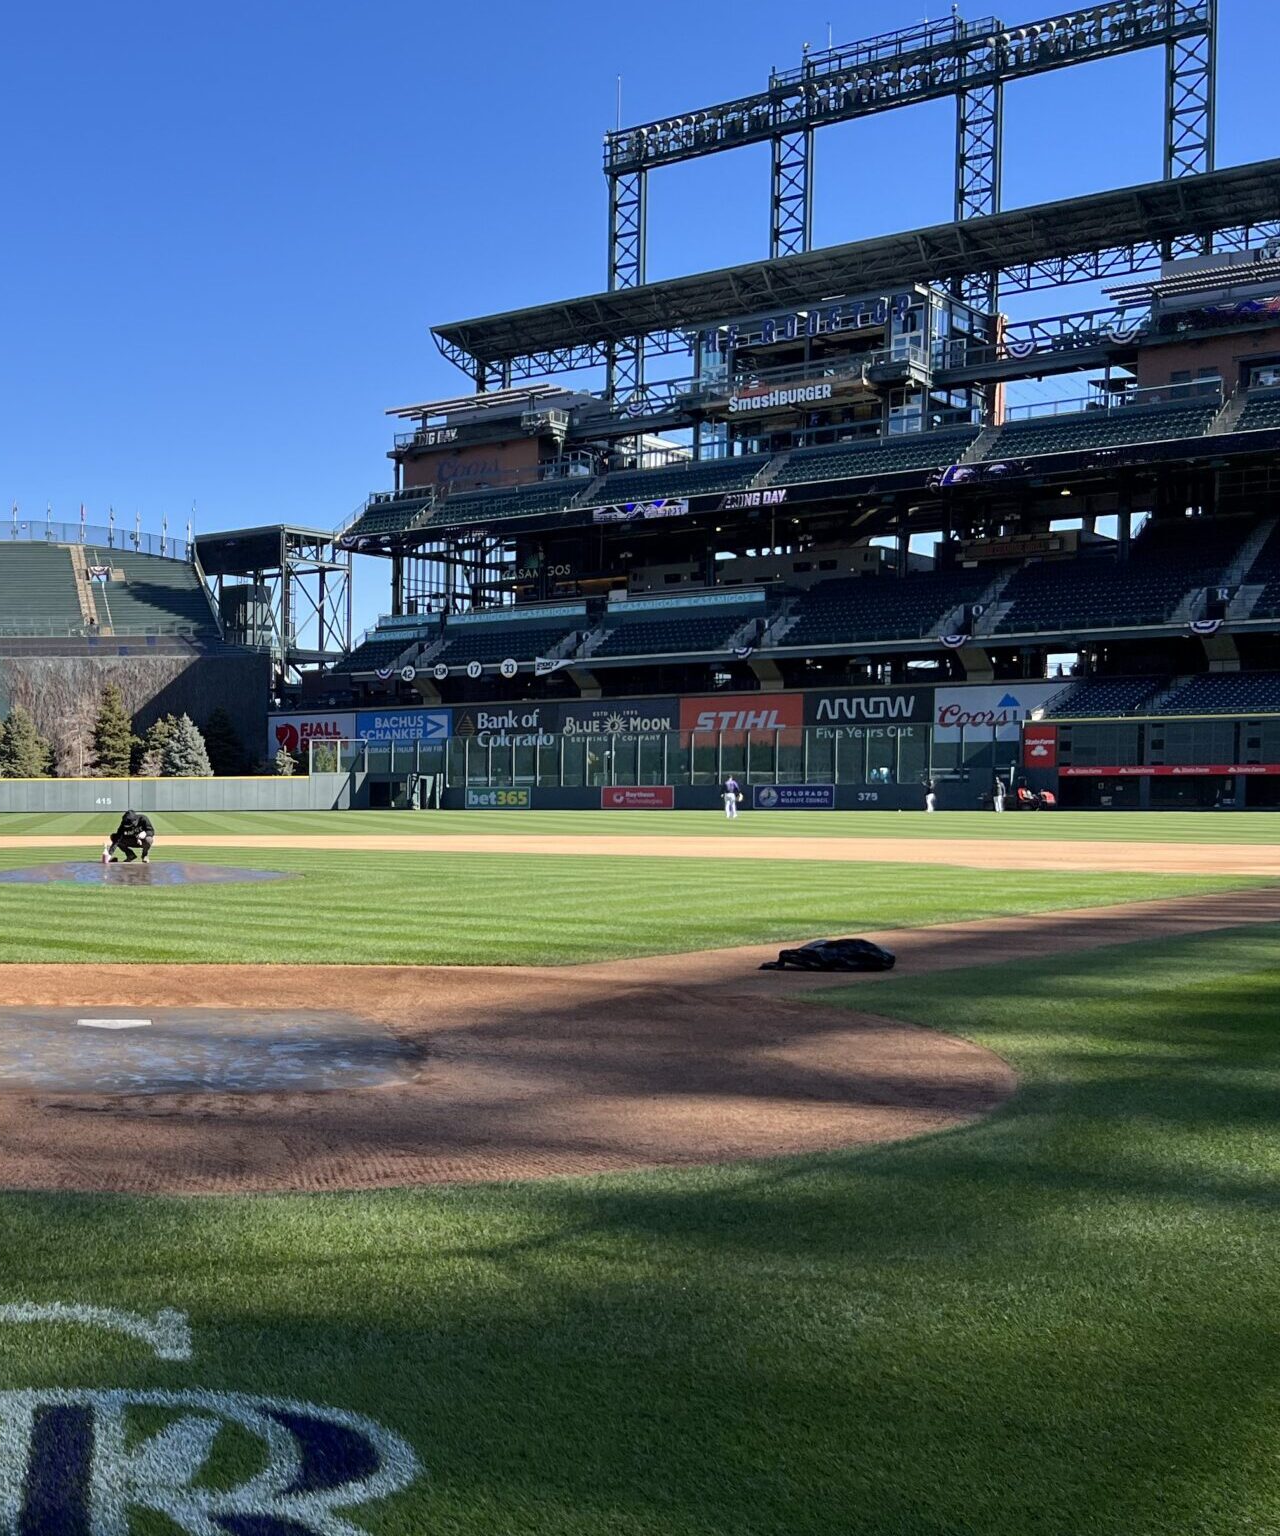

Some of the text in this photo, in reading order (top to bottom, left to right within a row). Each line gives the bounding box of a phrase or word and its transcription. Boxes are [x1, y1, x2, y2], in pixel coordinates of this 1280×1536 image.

[470, 665, 479, 675] 17
[503, 663, 514, 674] 33
[816, 695, 916, 720] ARROW
[374, 715, 424, 729] BACHUS
[477, 708, 540, 730] Bank of
[693, 709, 787, 733] STIHL
[938, 703, 1008, 728] Coors
[300, 722, 341, 737] FJALL
[562, 716, 670, 737] BLUE MOON
[816, 727, 843, 739] Five
[359, 728, 424, 741] SCHANKER
[477, 727, 555, 748] Colorado
[468, 790, 528, 806] bet365
[857, 792, 879, 802] 375
